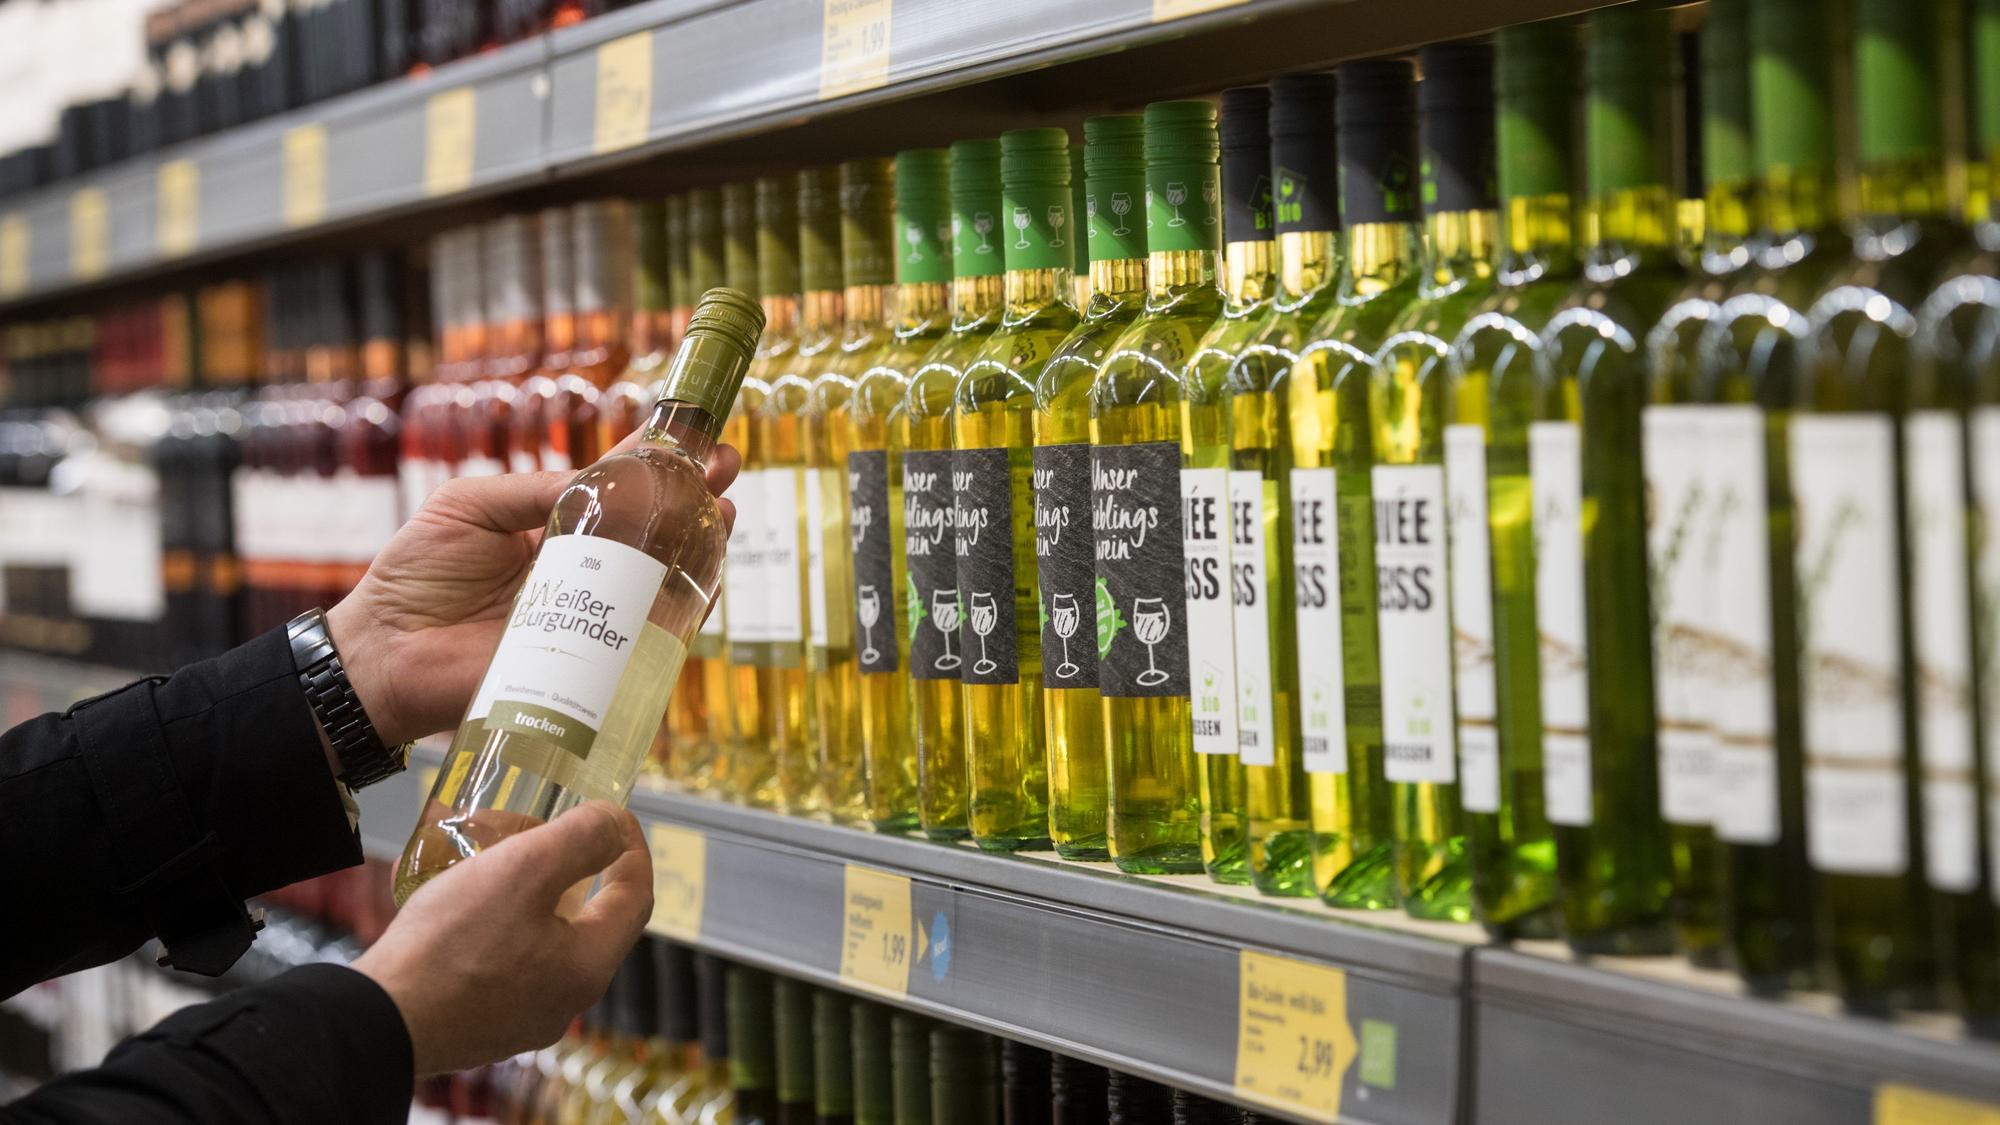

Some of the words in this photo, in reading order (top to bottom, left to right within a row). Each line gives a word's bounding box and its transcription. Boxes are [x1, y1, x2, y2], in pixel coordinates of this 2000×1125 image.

[580, 556, 602, 572] 2016
[528, 578, 616, 620] Weißer
[511, 602, 629, 651] Burgunder
[514, 711, 566, 738] trocken
[1297, 1034, 1333, 1081] 2,99
